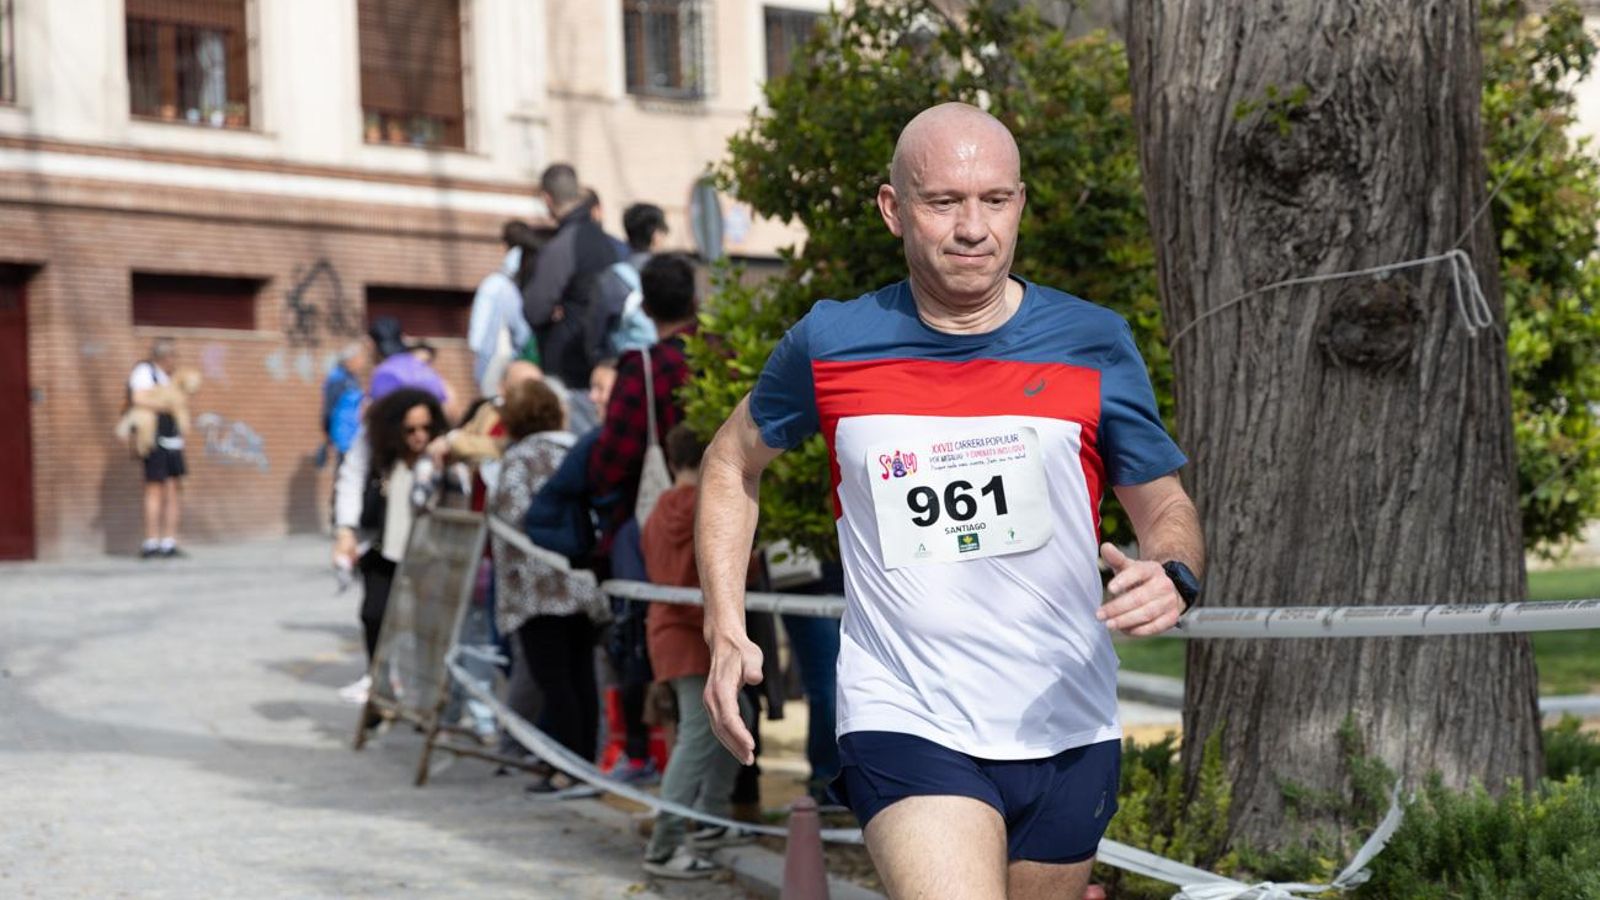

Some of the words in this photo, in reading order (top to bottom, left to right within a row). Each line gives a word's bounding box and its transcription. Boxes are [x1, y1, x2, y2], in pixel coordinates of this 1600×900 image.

[955, 438, 985, 450] CARRERA
[985, 433, 1020, 446] POPULAR
[906, 475, 1008, 527] 961
[944, 522, 987, 535] SANTIAGO
